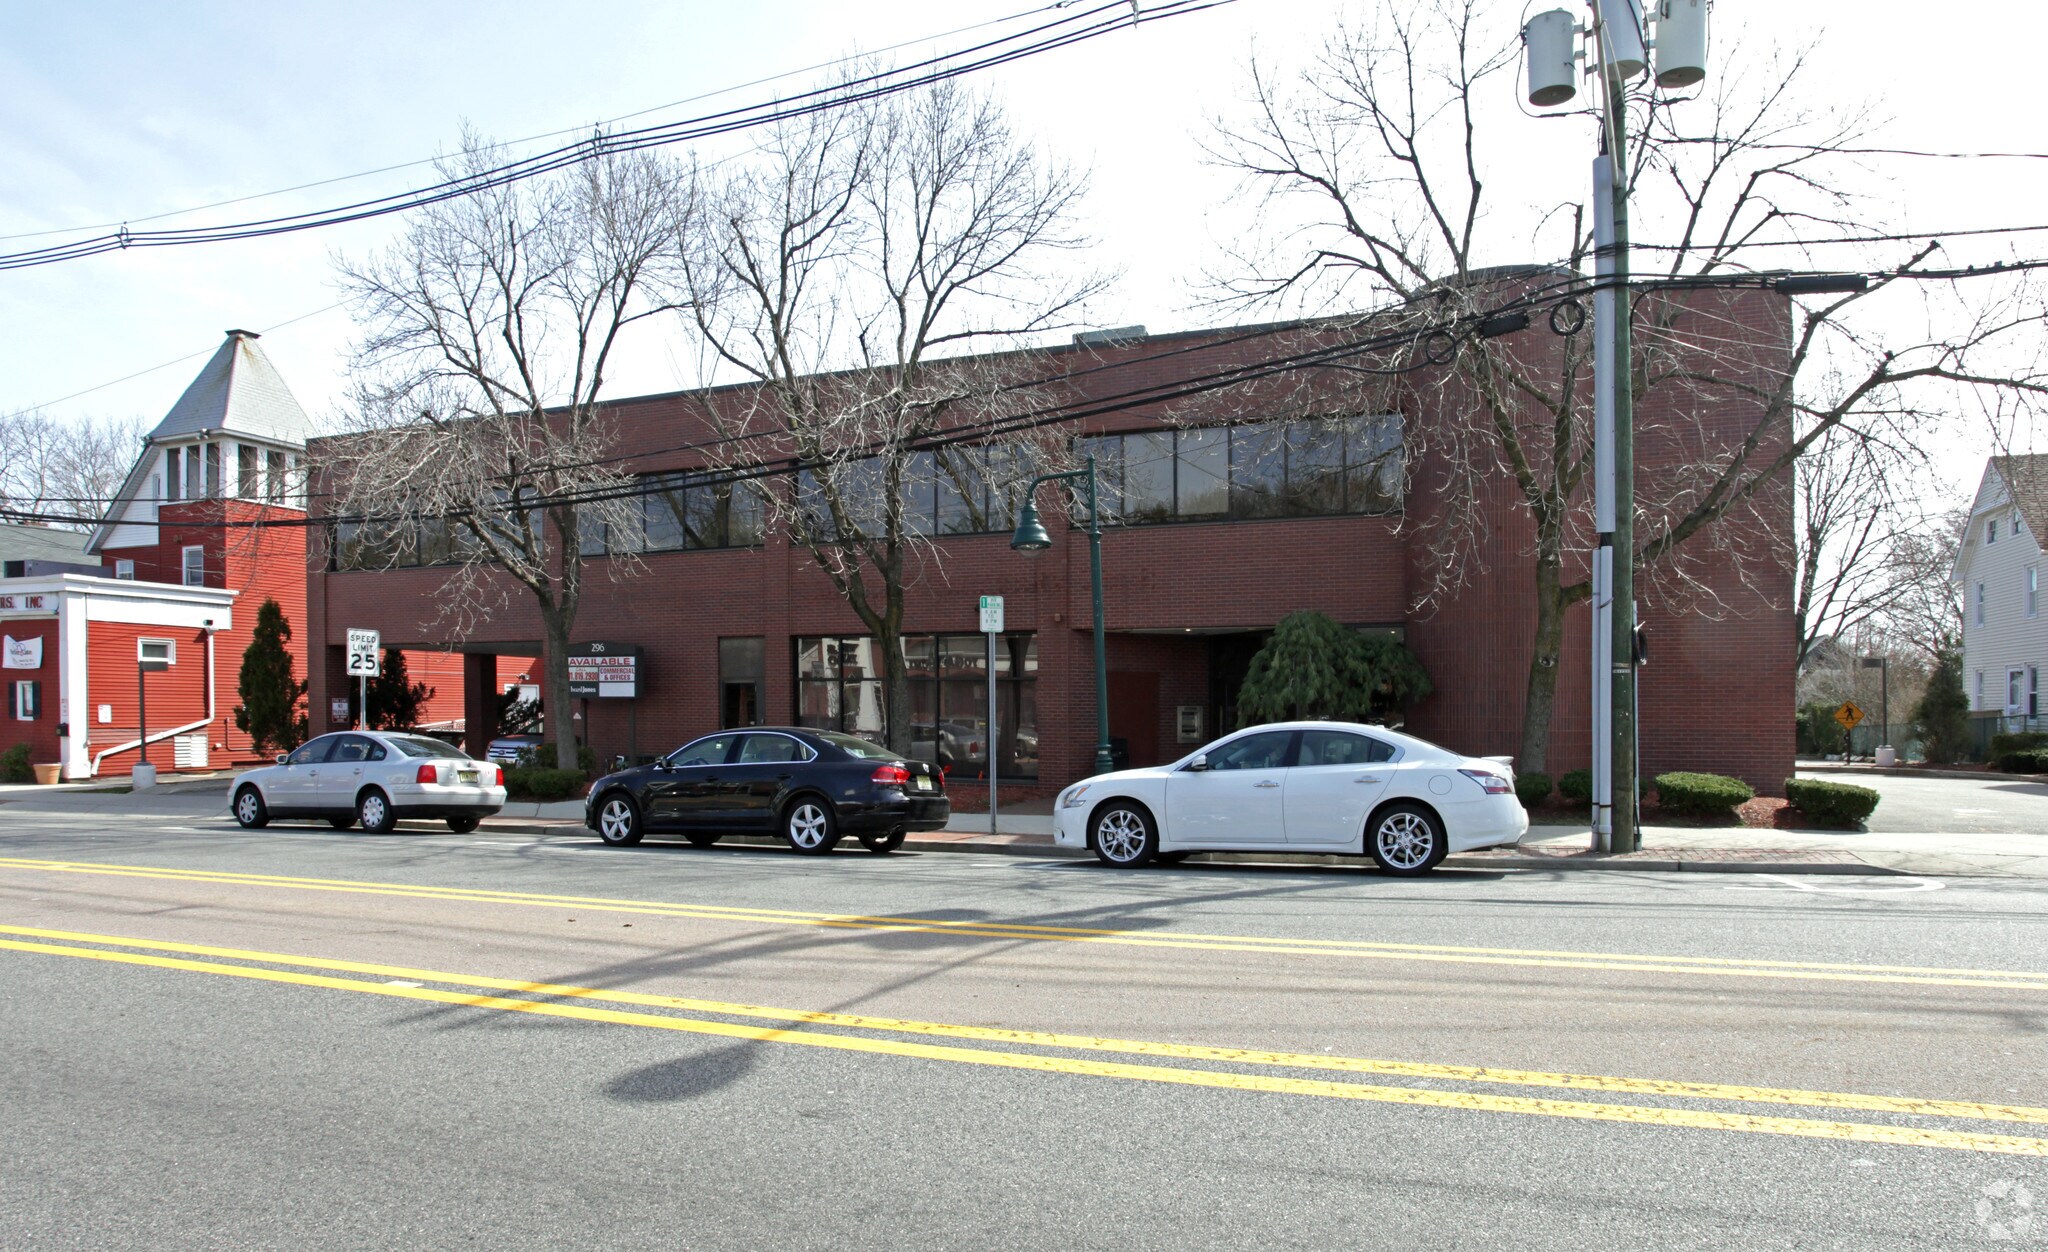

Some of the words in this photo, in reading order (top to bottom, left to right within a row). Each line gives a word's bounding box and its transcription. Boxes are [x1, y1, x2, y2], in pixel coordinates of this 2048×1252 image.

[351, 635, 376, 643] SPEED
[592, 644, 604, 652] 296
[351, 654, 375, 670] 25
